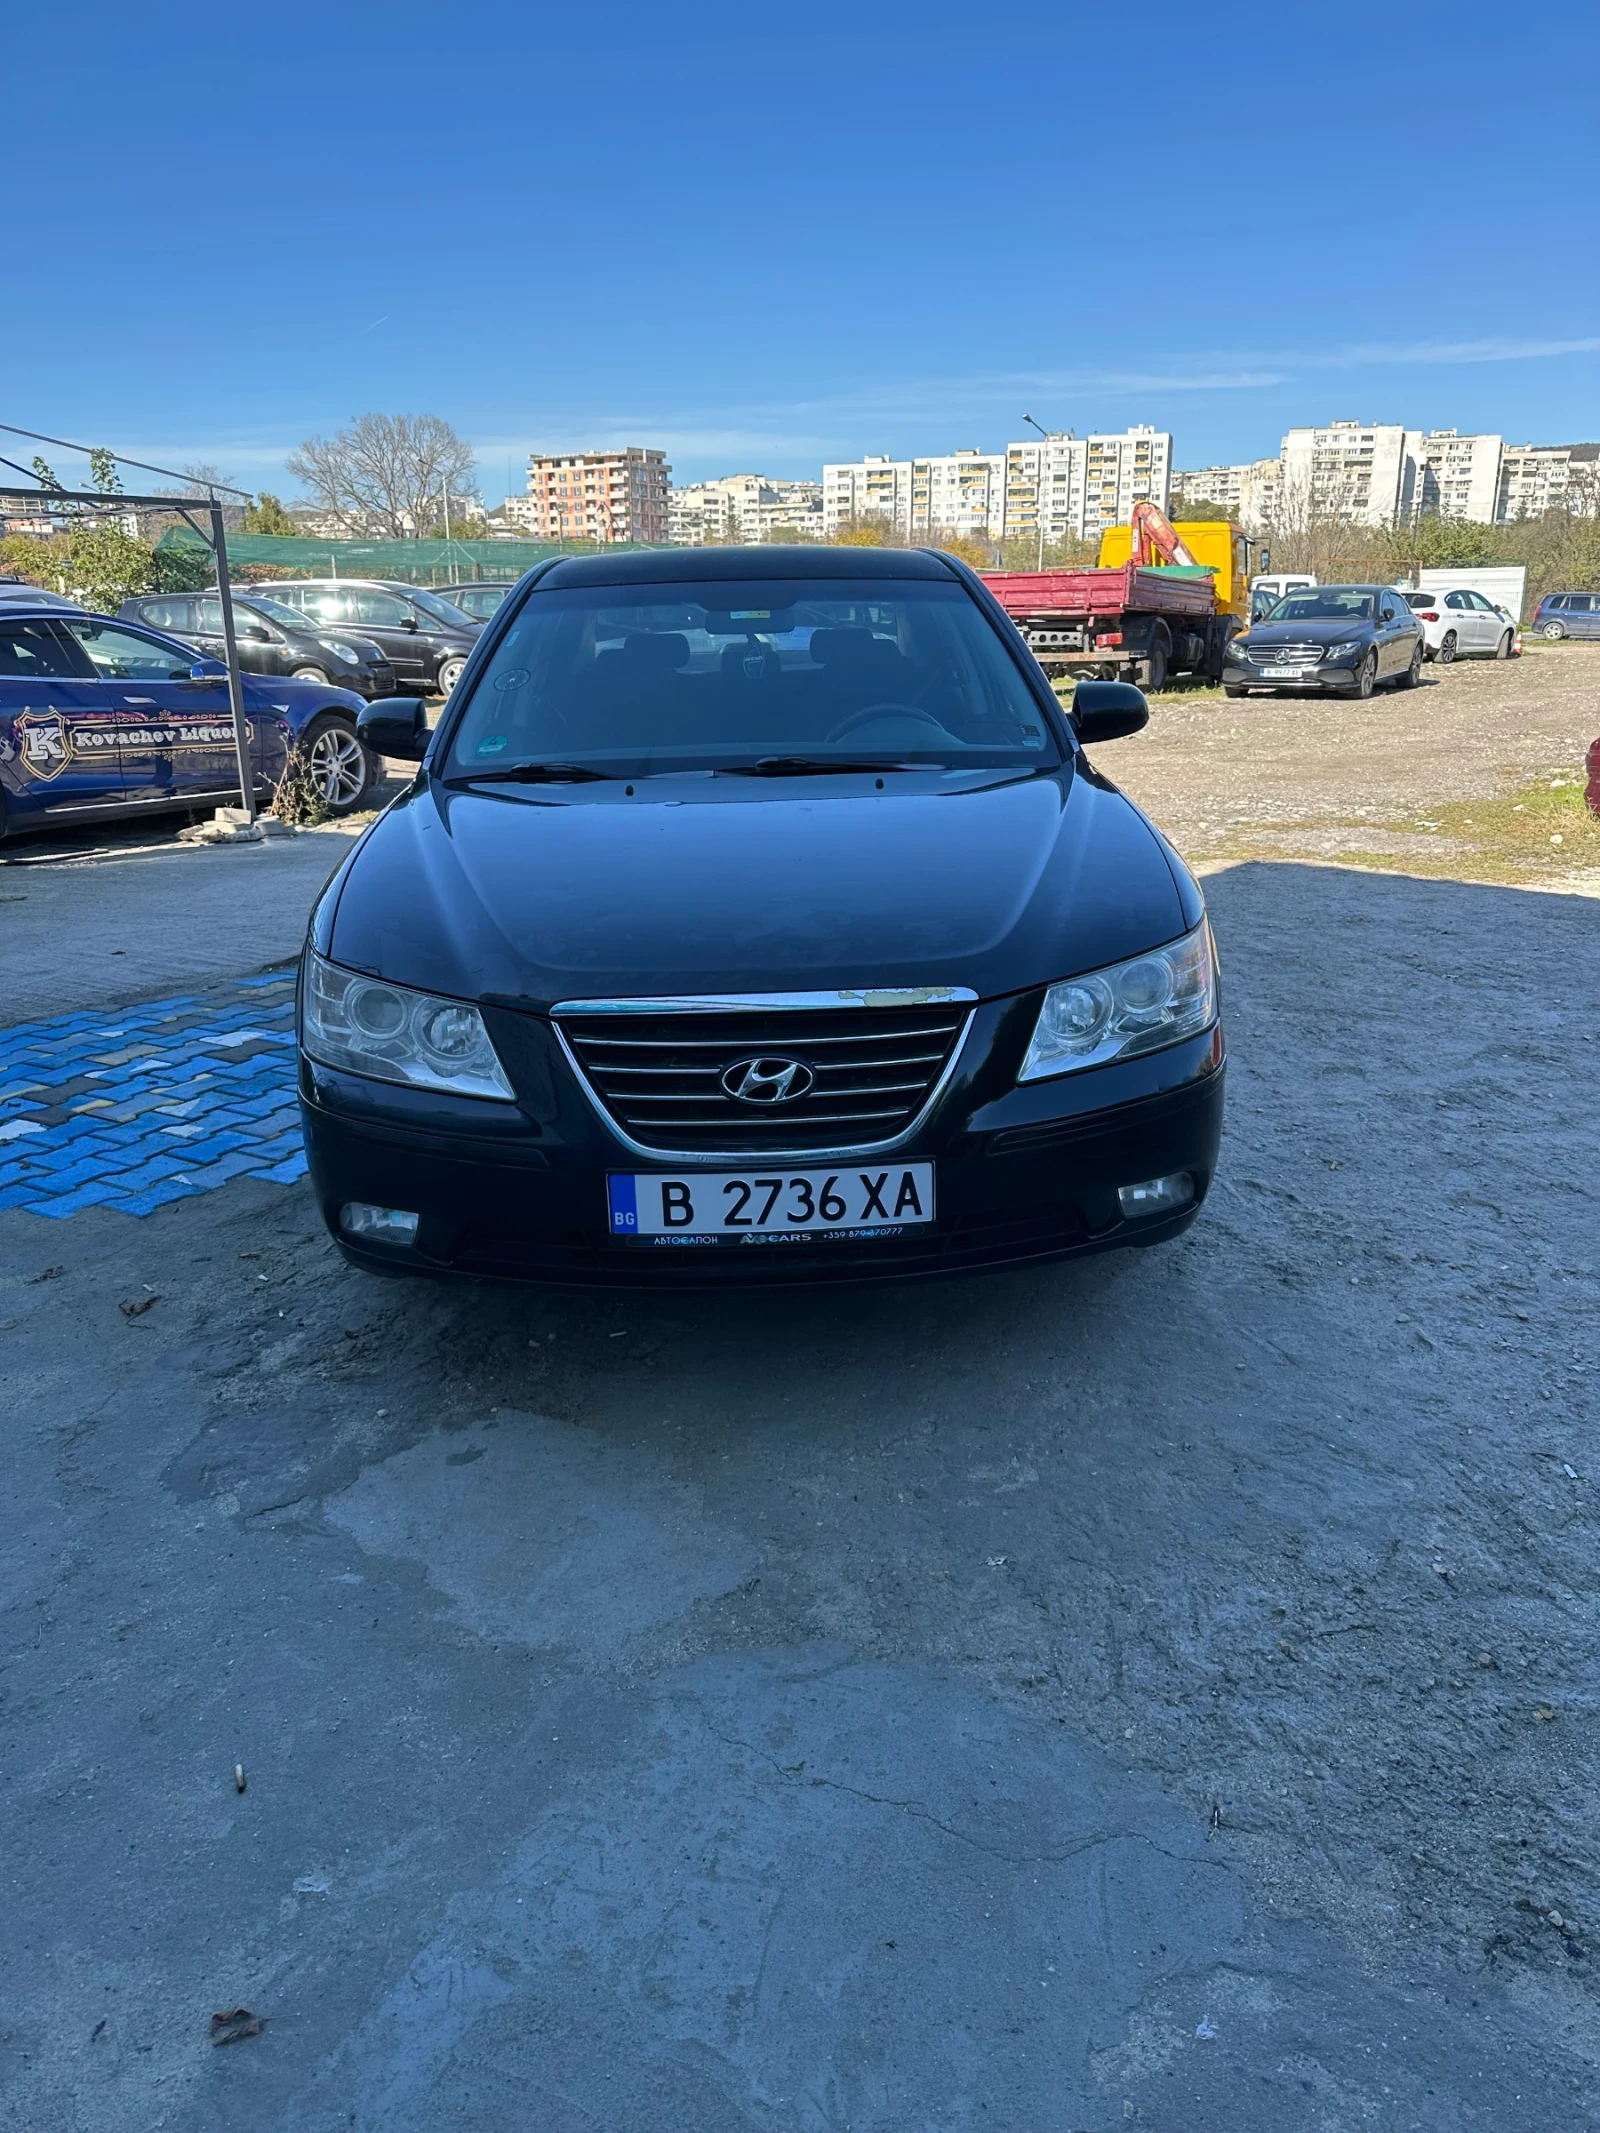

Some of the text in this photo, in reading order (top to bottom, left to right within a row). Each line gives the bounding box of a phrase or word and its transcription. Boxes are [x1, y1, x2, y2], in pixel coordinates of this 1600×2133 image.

[24, 727, 66, 760] K
[75, 730, 176, 747] Kovachev
[661, 1171, 923, 1227] B 2736 XA
[614, 1212, 635, 1226] BG
[823, 1231, 846, 1239] +359
